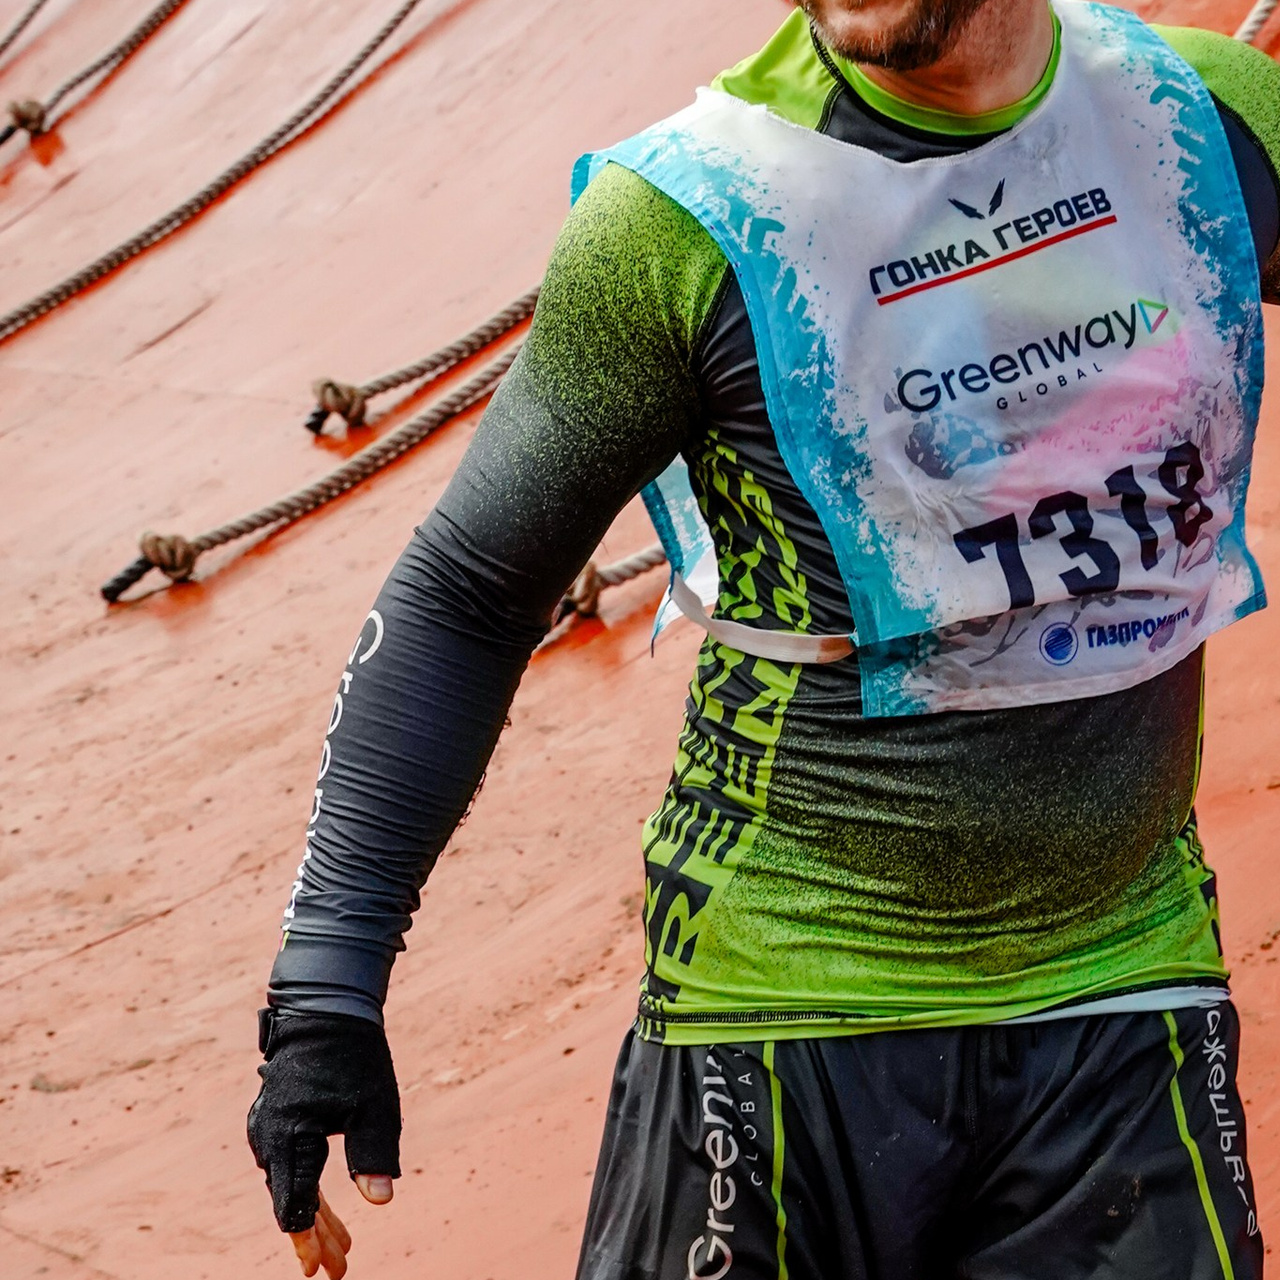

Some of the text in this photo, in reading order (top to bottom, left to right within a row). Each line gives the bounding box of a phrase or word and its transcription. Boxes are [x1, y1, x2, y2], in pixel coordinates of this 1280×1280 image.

[868, 187, 1112, 296] ГОНКА ГЕРОЕВ
[896, 302, 1137, 413] Greenway
[996, 362, 1104, 410] GLOBAL
[953, 440, 1214, 611] 7318
